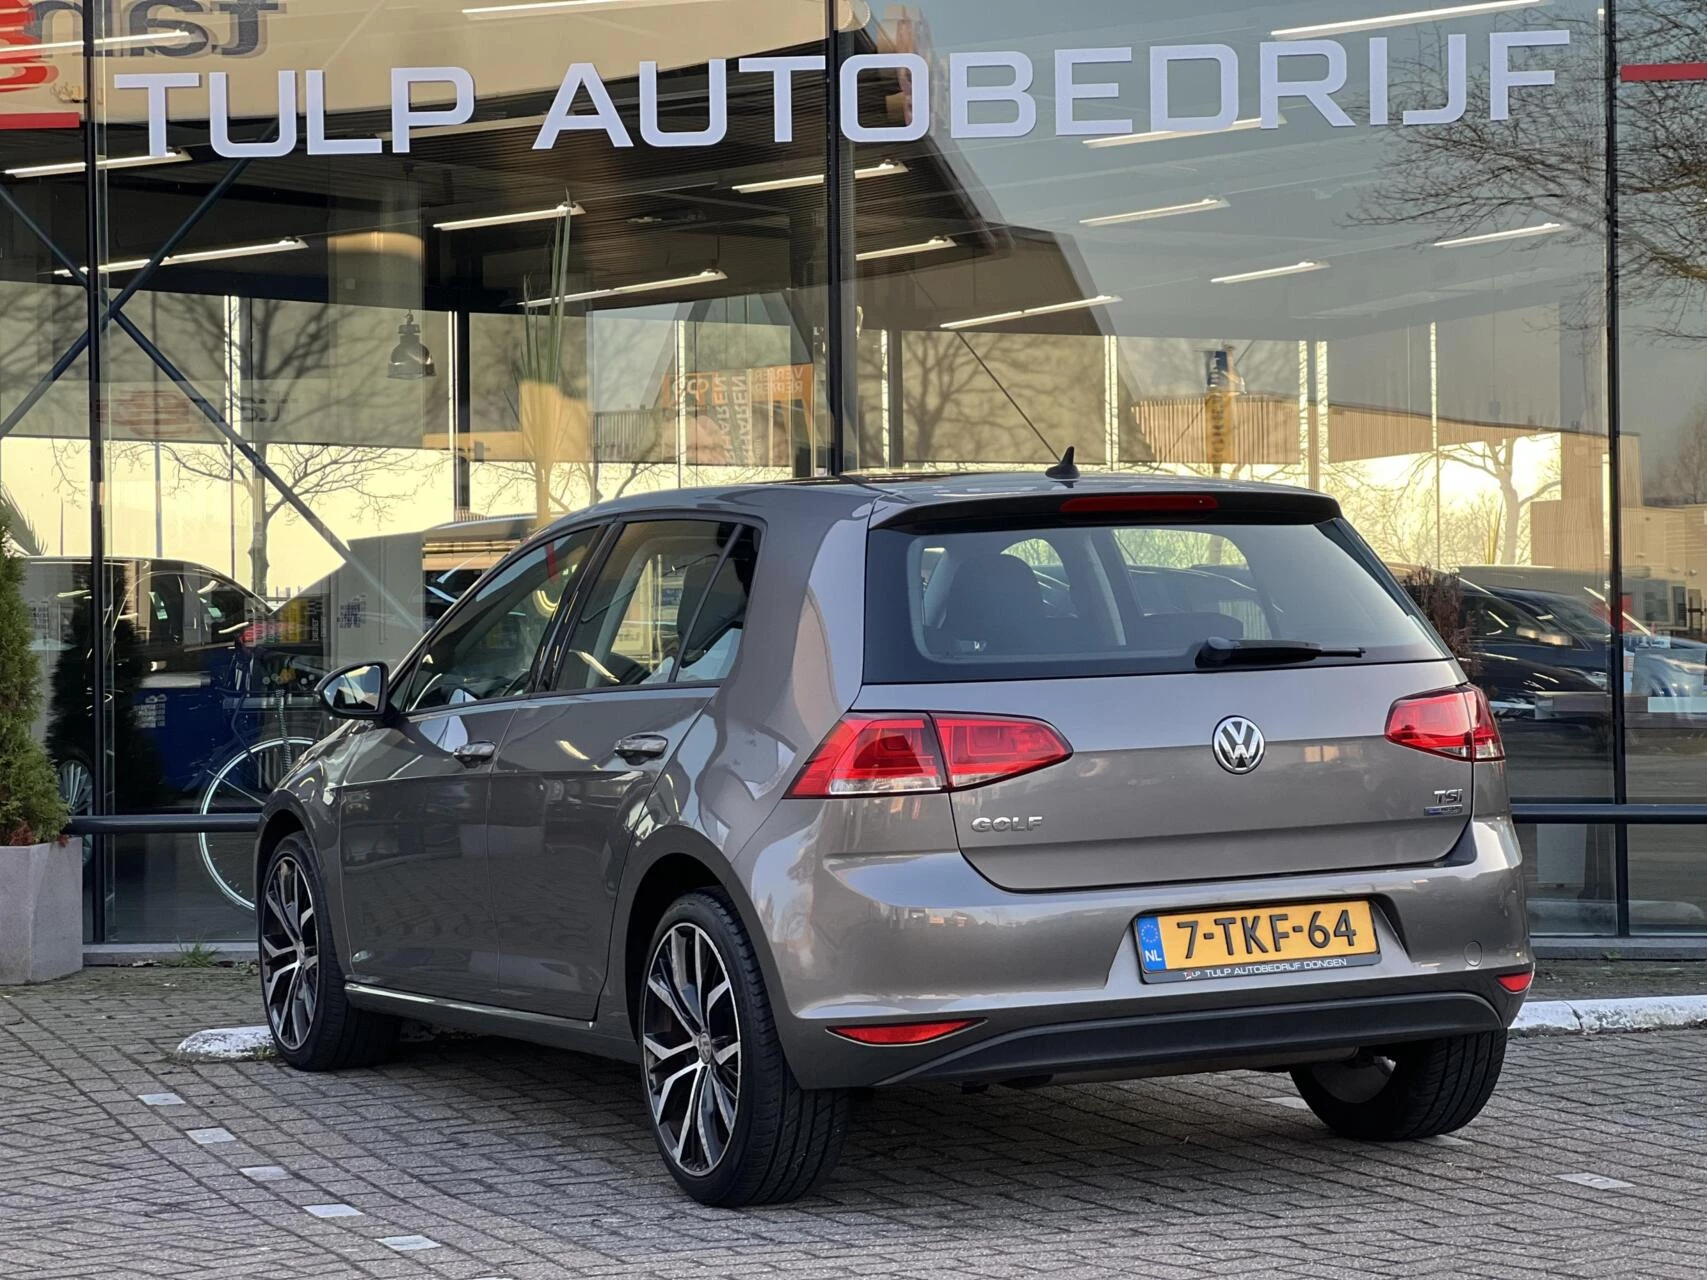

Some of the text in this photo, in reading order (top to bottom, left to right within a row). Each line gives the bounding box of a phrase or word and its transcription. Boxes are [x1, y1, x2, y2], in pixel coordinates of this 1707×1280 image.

[114, 29, 1571, 158] TULP AUTOBEDRIJF
[971, 816, 1043, 832] GOLF
[1177, 909, 1357, 959] 7-TKF-64
[1144, 949, 1163, 962] NL
[1205, 967, 1231, 978] TULP
[1234, 961, 1301, 975] AUTOBEDRIJF
[1304, 958, 1348, 969] DONGEN
